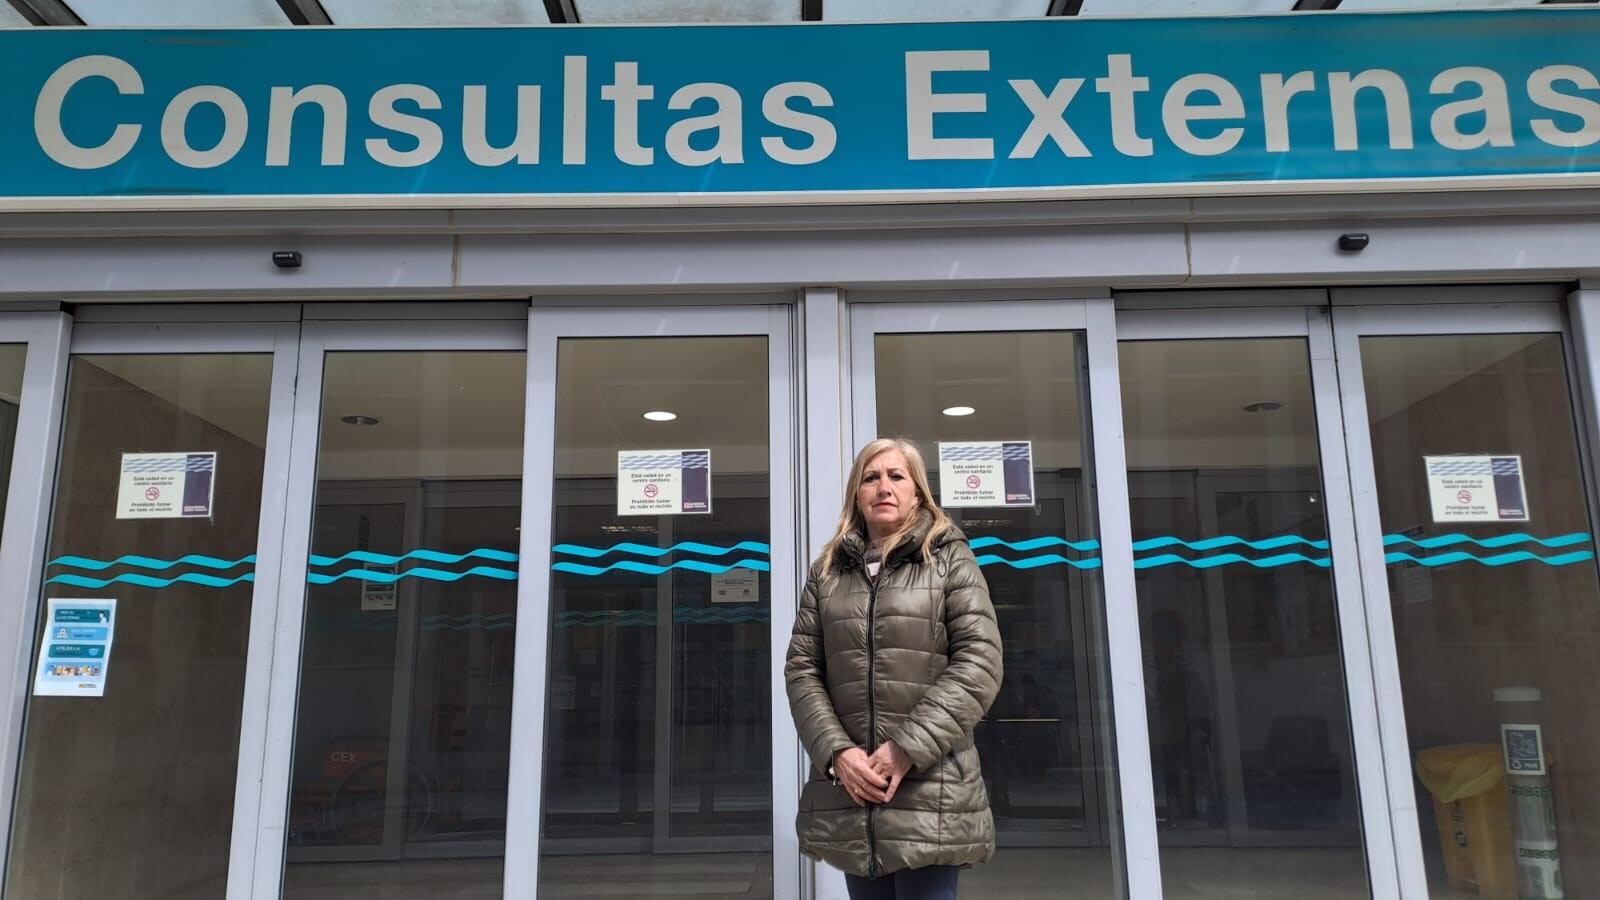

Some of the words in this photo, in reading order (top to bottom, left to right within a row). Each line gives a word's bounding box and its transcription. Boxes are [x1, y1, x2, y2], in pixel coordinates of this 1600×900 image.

[34, 54, 838, 170] Consultas
[904, 49, 1600, 161] Externas
[331, 751, 356, 762] CEX
